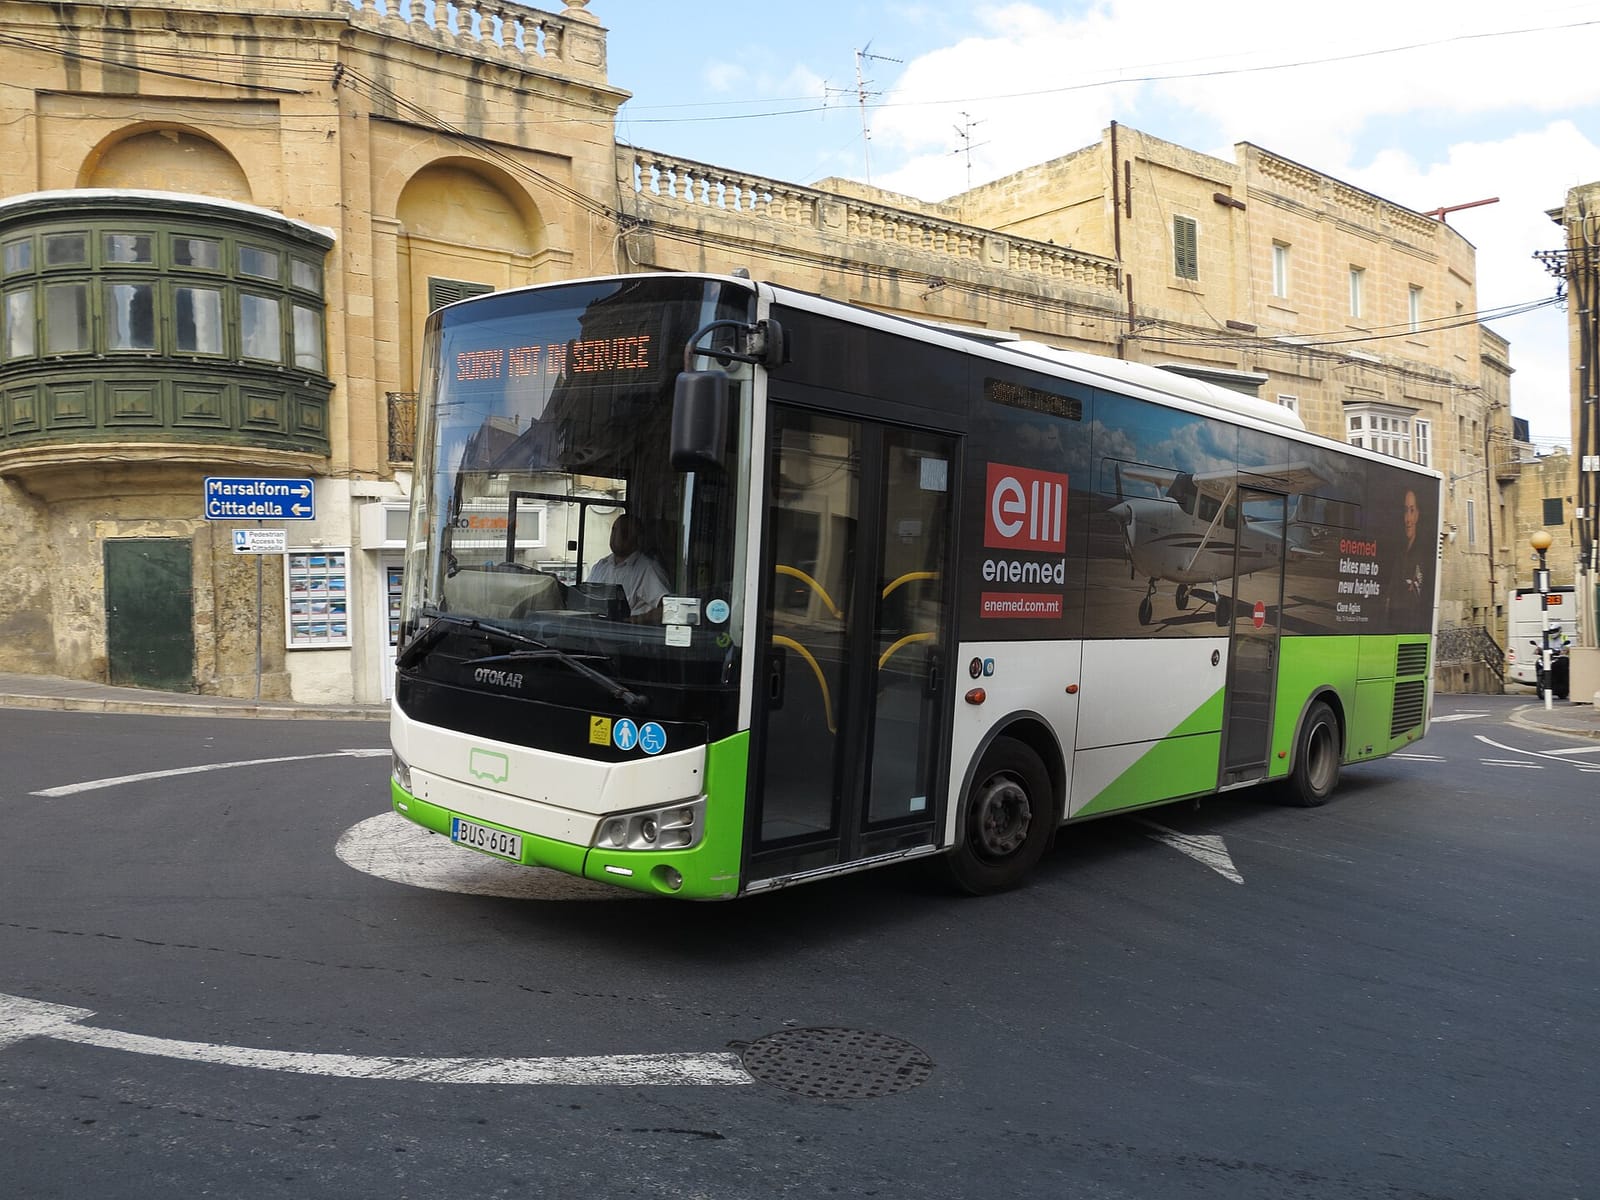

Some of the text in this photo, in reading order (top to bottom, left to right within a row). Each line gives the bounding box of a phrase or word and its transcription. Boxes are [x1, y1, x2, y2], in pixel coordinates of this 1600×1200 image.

[456, 335, 650, 381] SORRY NOT IN SERVICE
[209, 481, 289, 496] Marsalforn
[1340, 539, 1376, 556] enemed
[982, 558, 1066, 585] enemed
[1340, 558, 1379, 575] takes me to
[1338, 579, 1380, 598] new heights
[984, 599, 1060, 613] enemed.com.mt
[474, 668, 523, 688] OTOKAR
[460, 823, 516, 856] BUS 601
